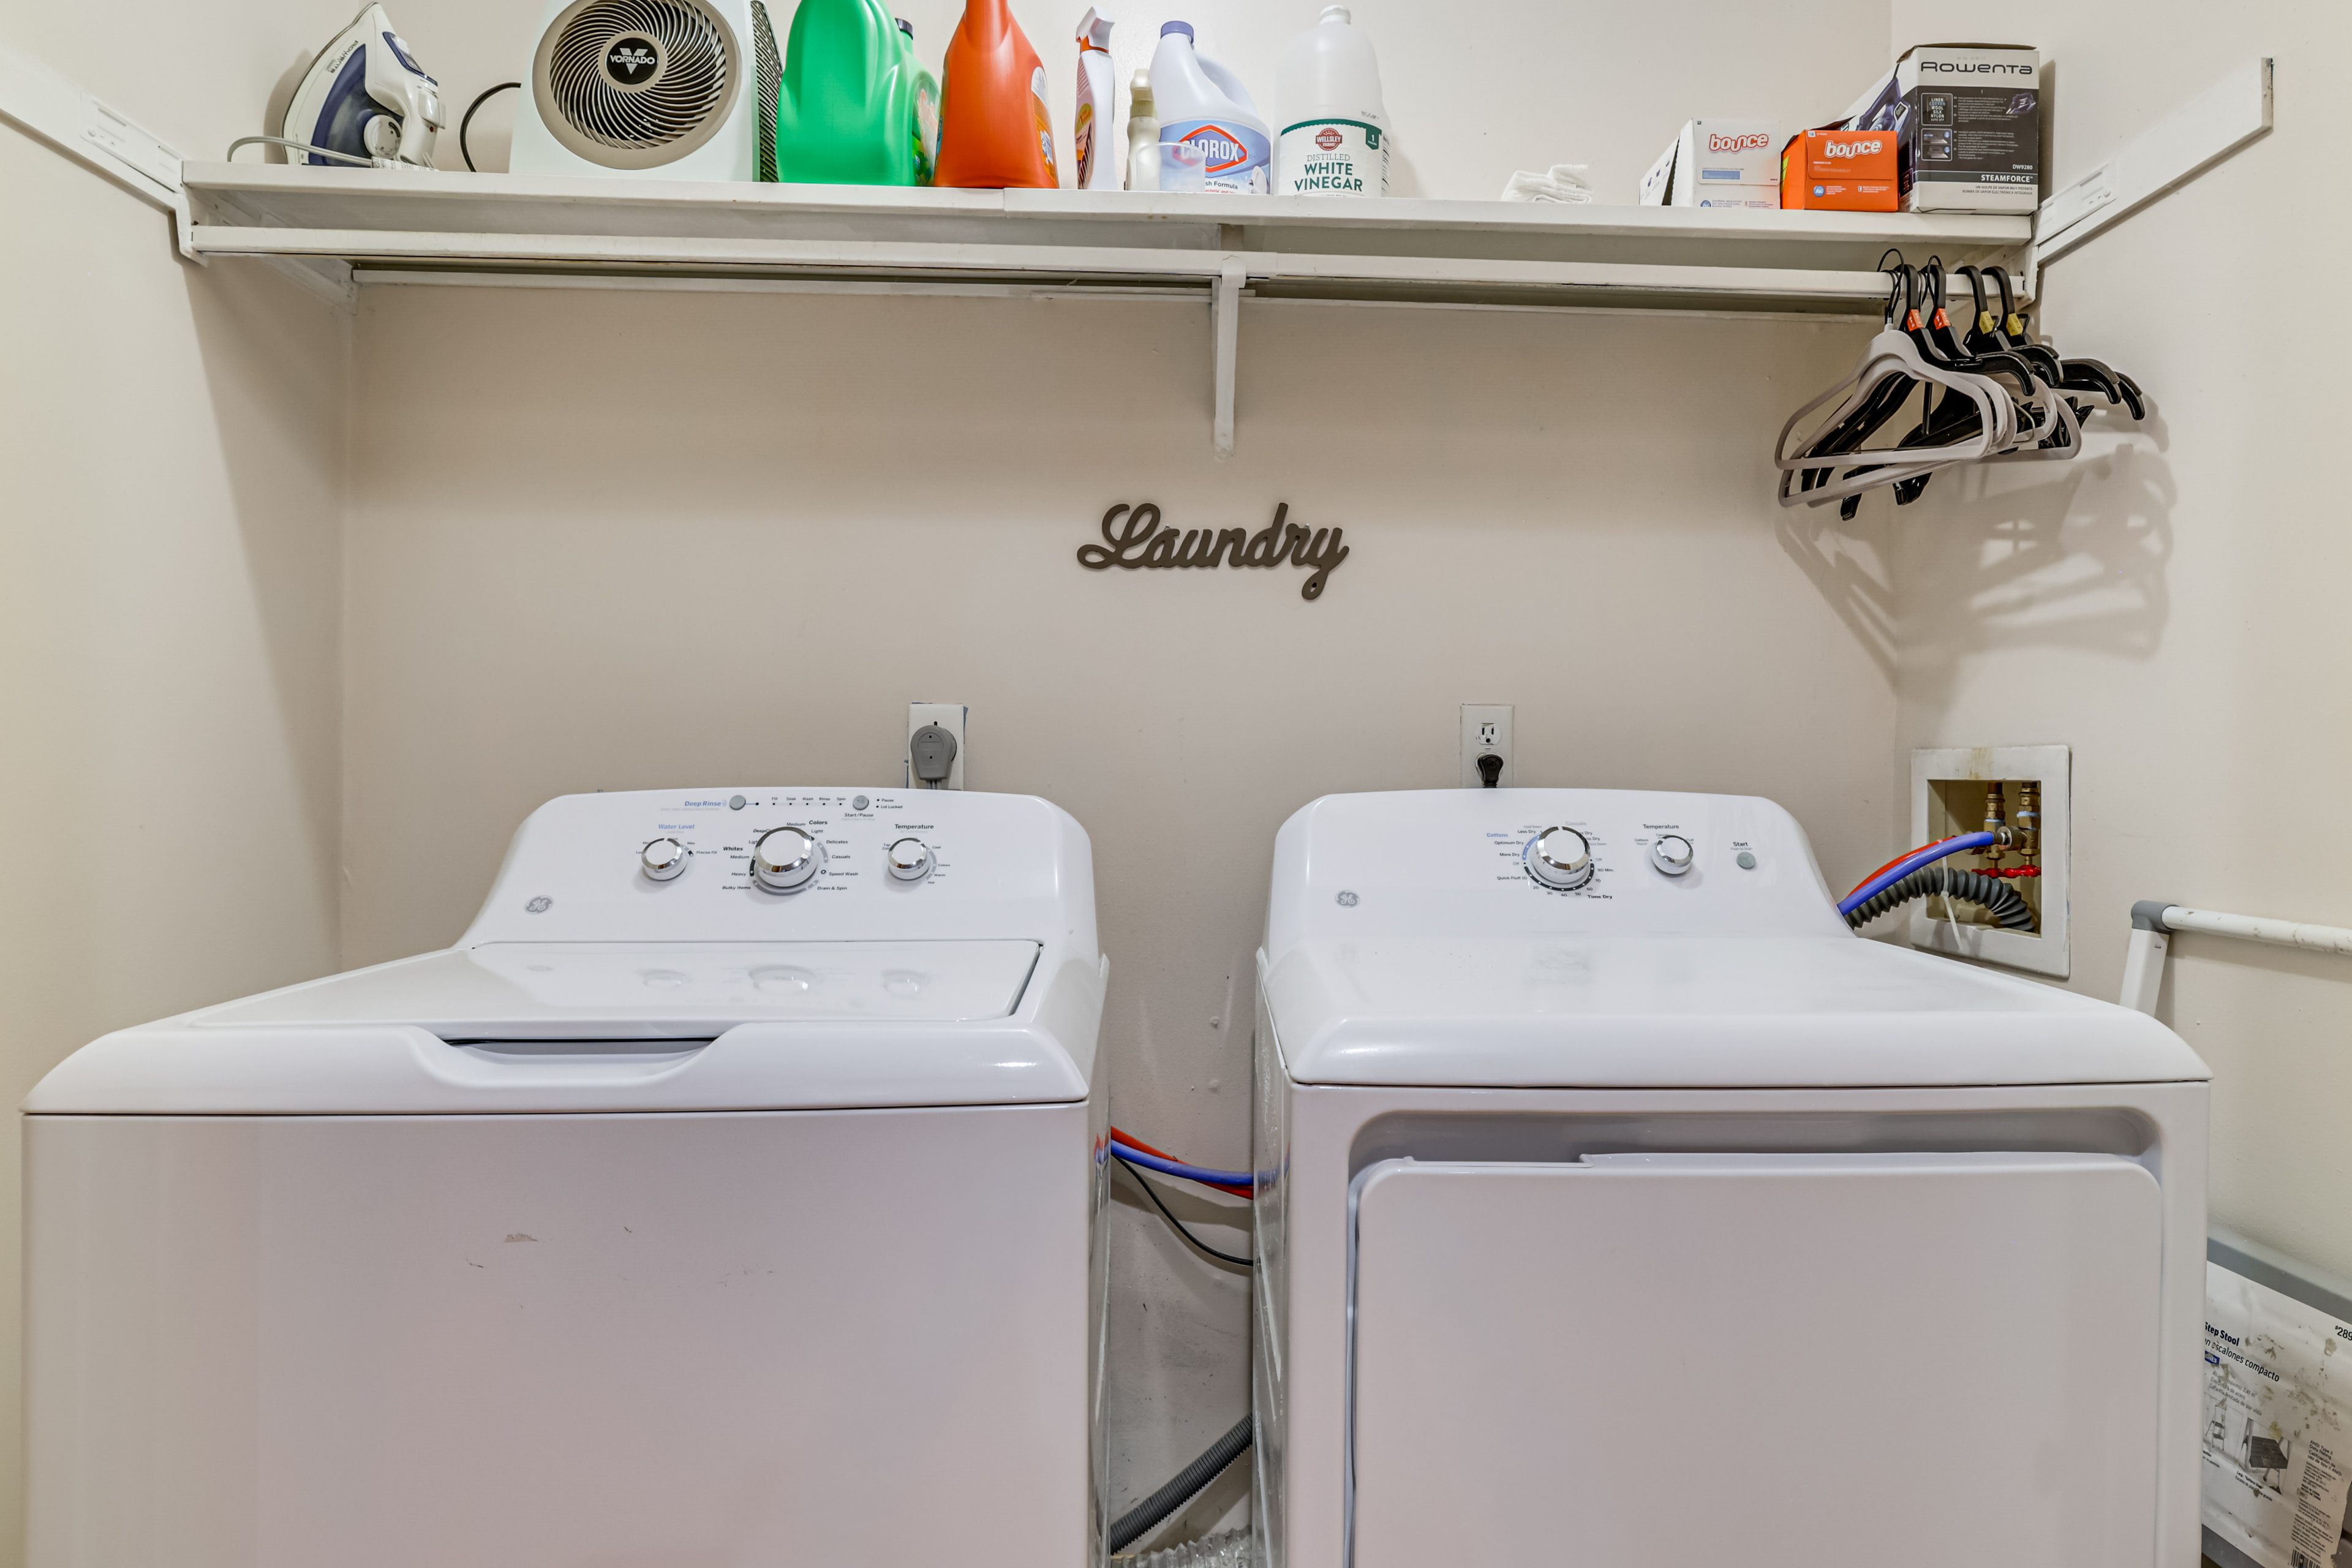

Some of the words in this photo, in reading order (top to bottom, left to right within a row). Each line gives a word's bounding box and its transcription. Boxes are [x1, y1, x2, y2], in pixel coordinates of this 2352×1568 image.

[609, 55, 655, 64] VORNADO
[1708, 134, 1770, 153] bounce
[1825, 140, 1882, 159] bounce
[1307, 153, 1351, 162] DISTILLED
[1304, 162, 1353, 176] WHITE
[1213, 181, 1238, 189] Formula
[1294, 176, 1363, 192] VINEGAR
[1076, 502, 1349, 600] Laundry
[2220, 1330, 2240, 1347] Stool
[2211, 1342, 2244, 1363] escalones
[2245, 1359, 2280, 1382] compacto
